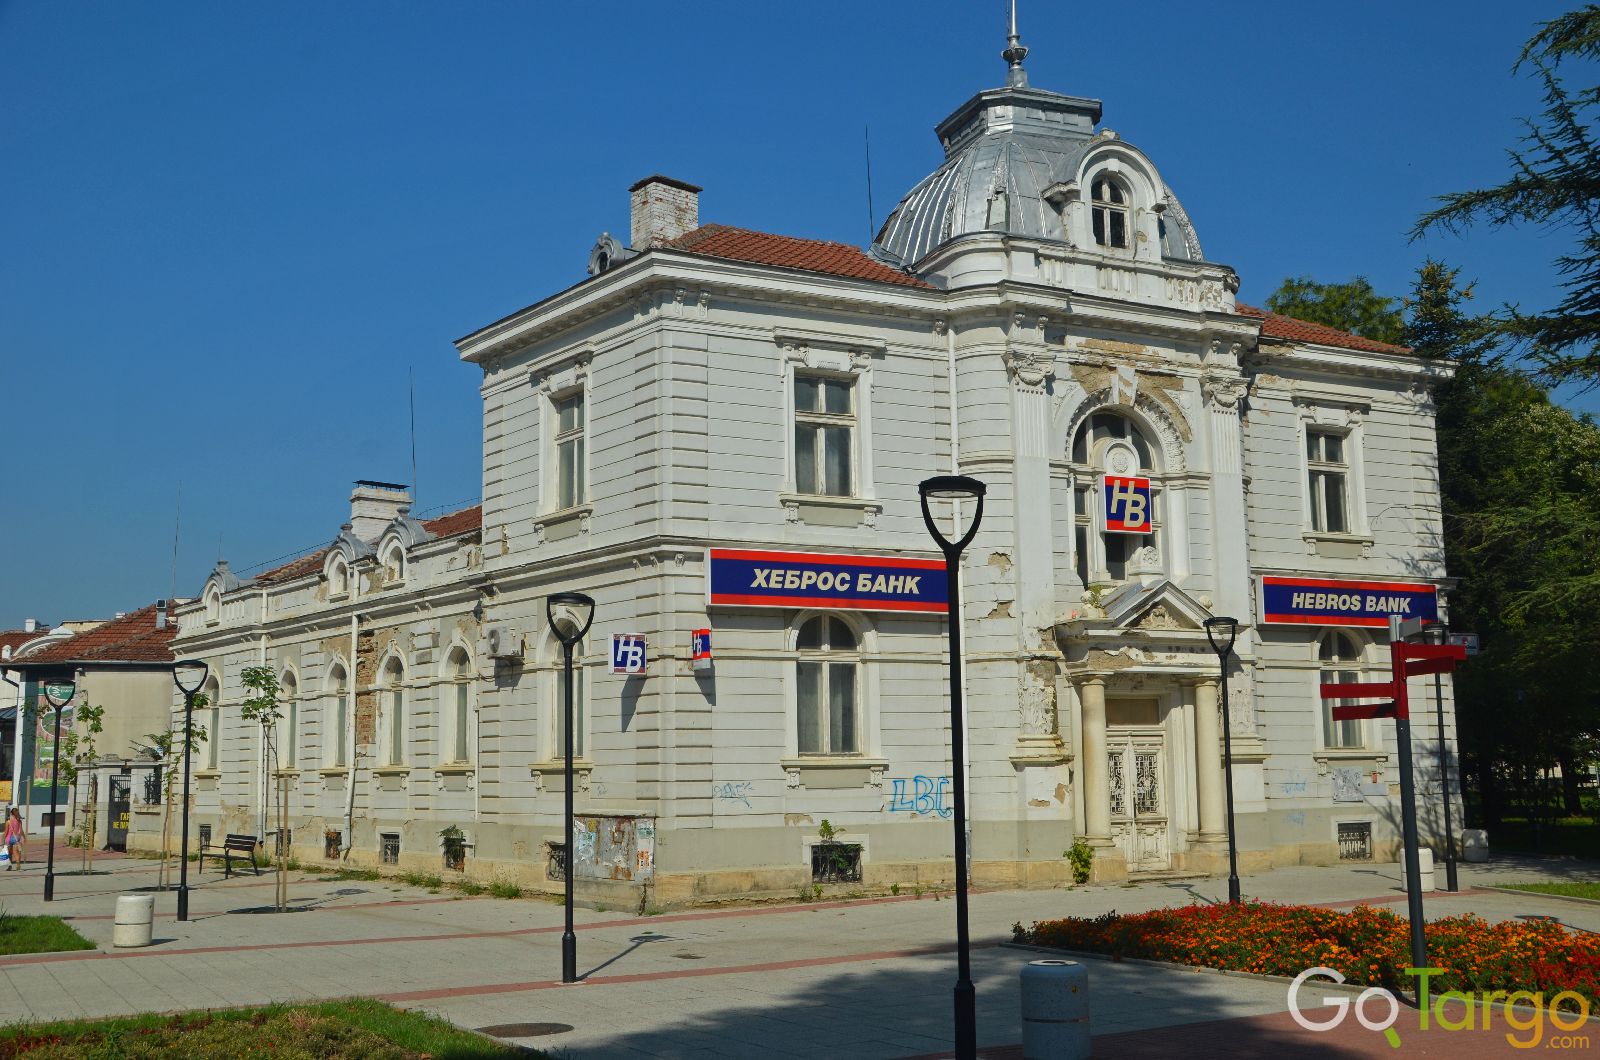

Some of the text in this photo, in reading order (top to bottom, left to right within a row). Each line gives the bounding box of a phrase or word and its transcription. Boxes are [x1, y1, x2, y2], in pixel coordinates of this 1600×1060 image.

[1110, 479, 1147, 528] HB
[750, 568, 922, 594] ХЕБРОС БАНК
[1291, 592, 1412, 613] HEBROS BANK
[616, 635, 643, 673] HB
